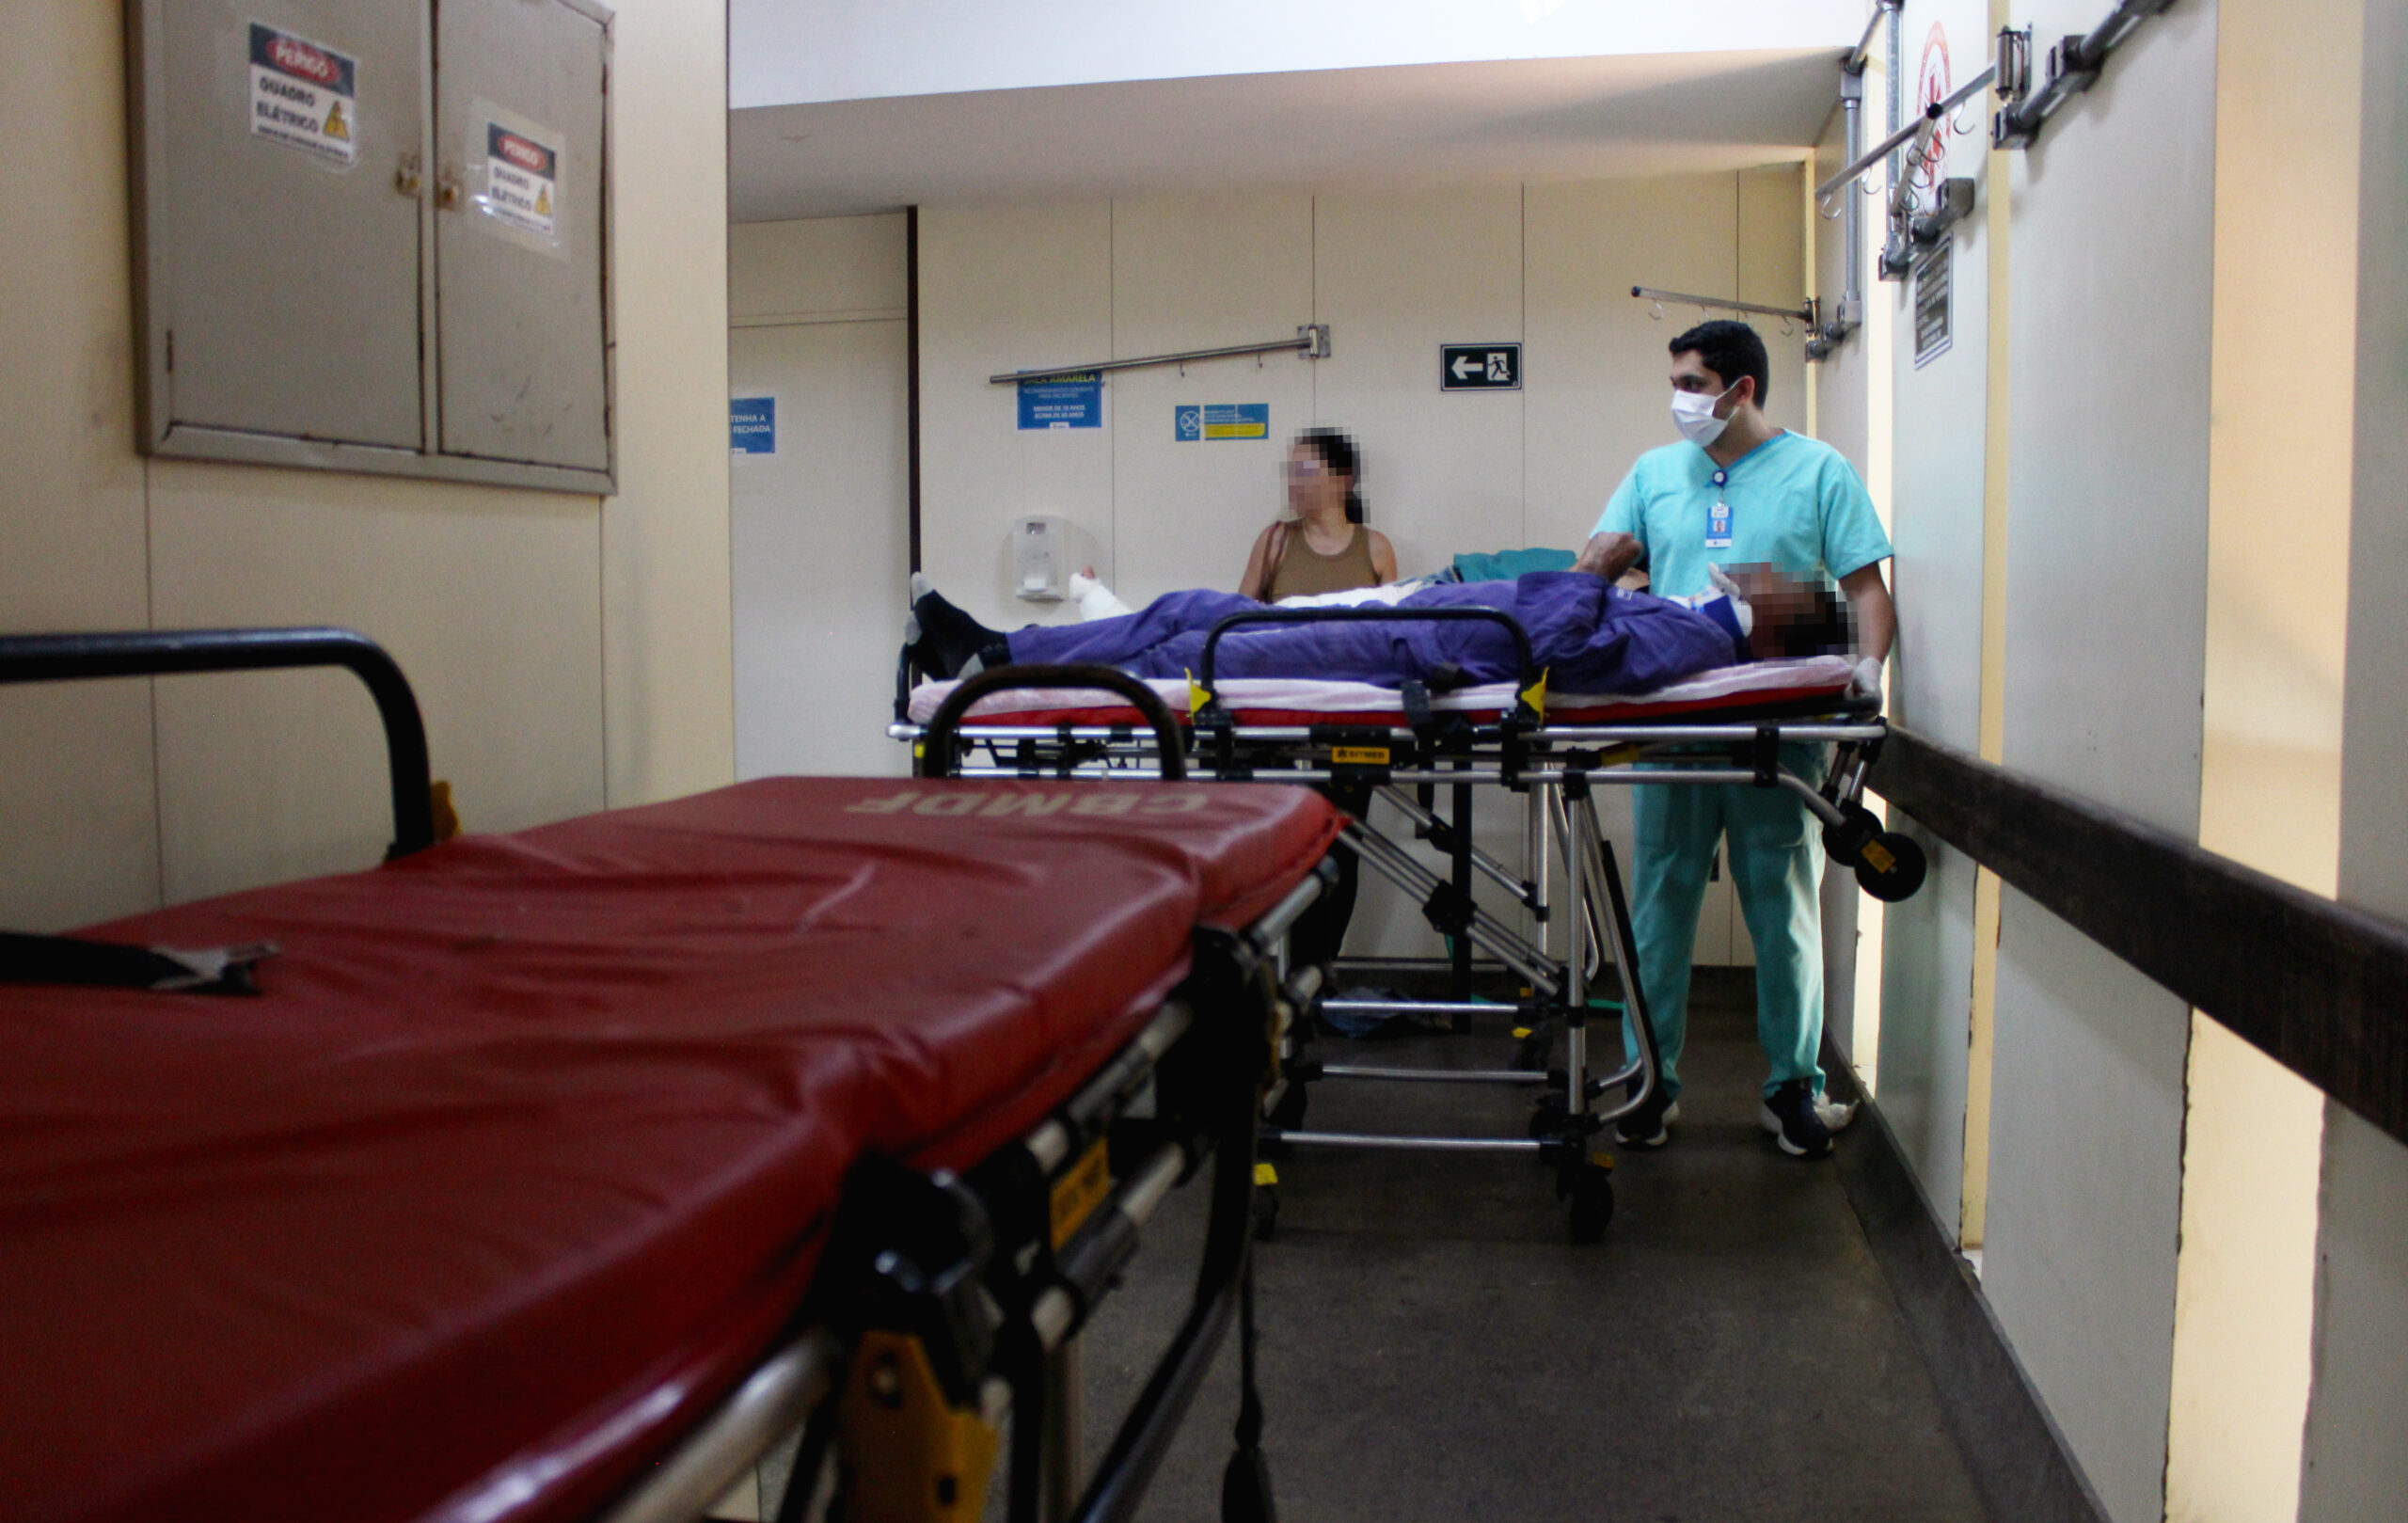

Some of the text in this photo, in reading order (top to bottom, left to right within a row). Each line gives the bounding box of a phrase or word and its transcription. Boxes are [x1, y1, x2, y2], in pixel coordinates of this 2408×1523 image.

[259, 76, 315, 107] QUADRO
[1050, 373, 1096, 383] AMARELA
[844, 791, 1209, 817] CBMDF
